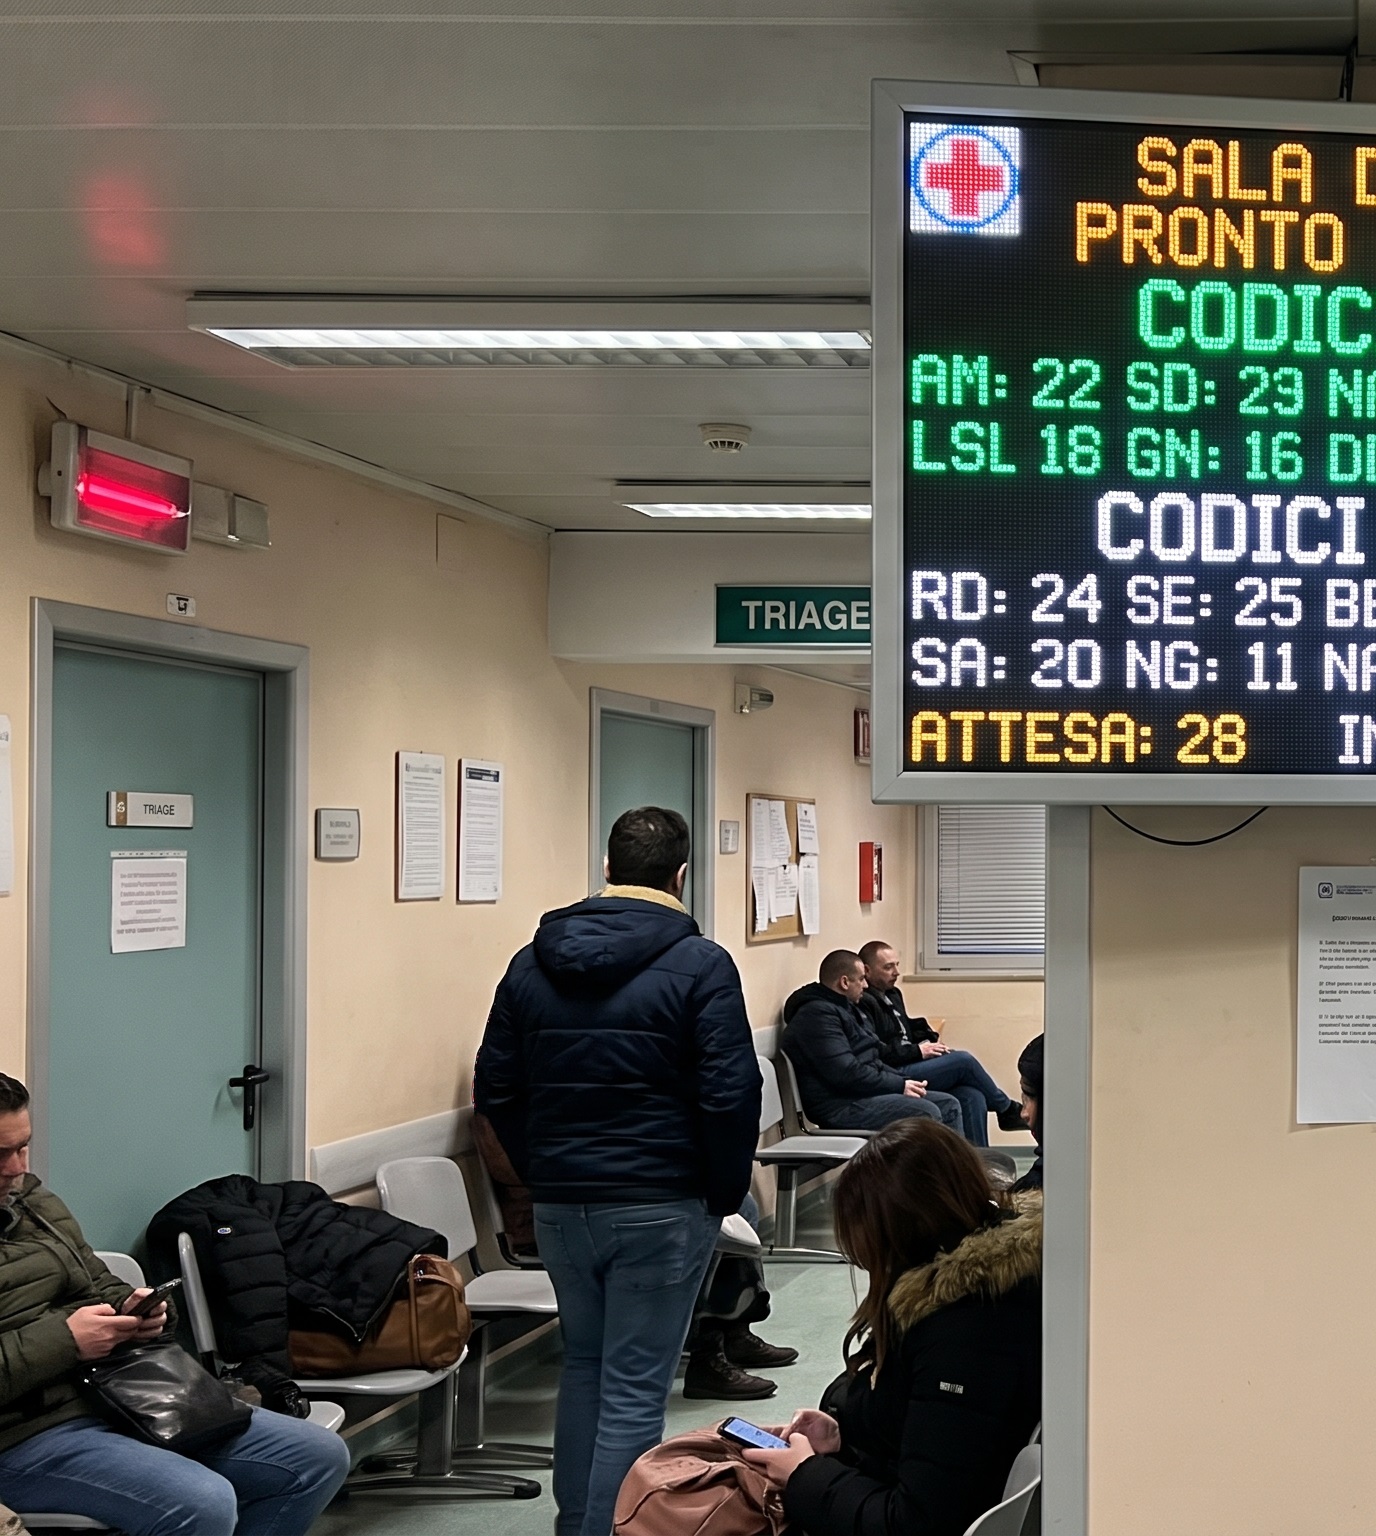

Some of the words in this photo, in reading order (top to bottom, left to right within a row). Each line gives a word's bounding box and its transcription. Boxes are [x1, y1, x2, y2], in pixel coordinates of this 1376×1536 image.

[1138, 137, 1311, 203] SALA
[1076, 202, 1343, 272] PRONTO
[912, 354, 1006, 405] AM:
[1033, 358, 1100, 410] 22
[1127, 362, 1215, 412] SD:
[913, 420, 1016, 473] LSL
[1041, 424, 1101, 475] 18
[1128, 427, 1219, 478] GN:
[1246, 431, 1303, 481] 16
[1098, 491, 1365, 565] CODICI
[741, 600, 871, 630] TRIAGE
[912, 571, 1006, 620] RD:
[1032, 573, 1102, 623] 24
[1127, 575, 1211, 625] SE:
[1235, 577, 1302, 626] 25
[912, 638, 1006, 687] SA:
[1031, 639, 1101, 688] 20
[1126, 640, 1217, 689] NG:
[1247, 642, 1297, 690] 11
[912, 711, 1151, 763] ATTESA:
[1177, 714, 1246, 763] 28
[143, 804, 175, 815] TRIAGE
